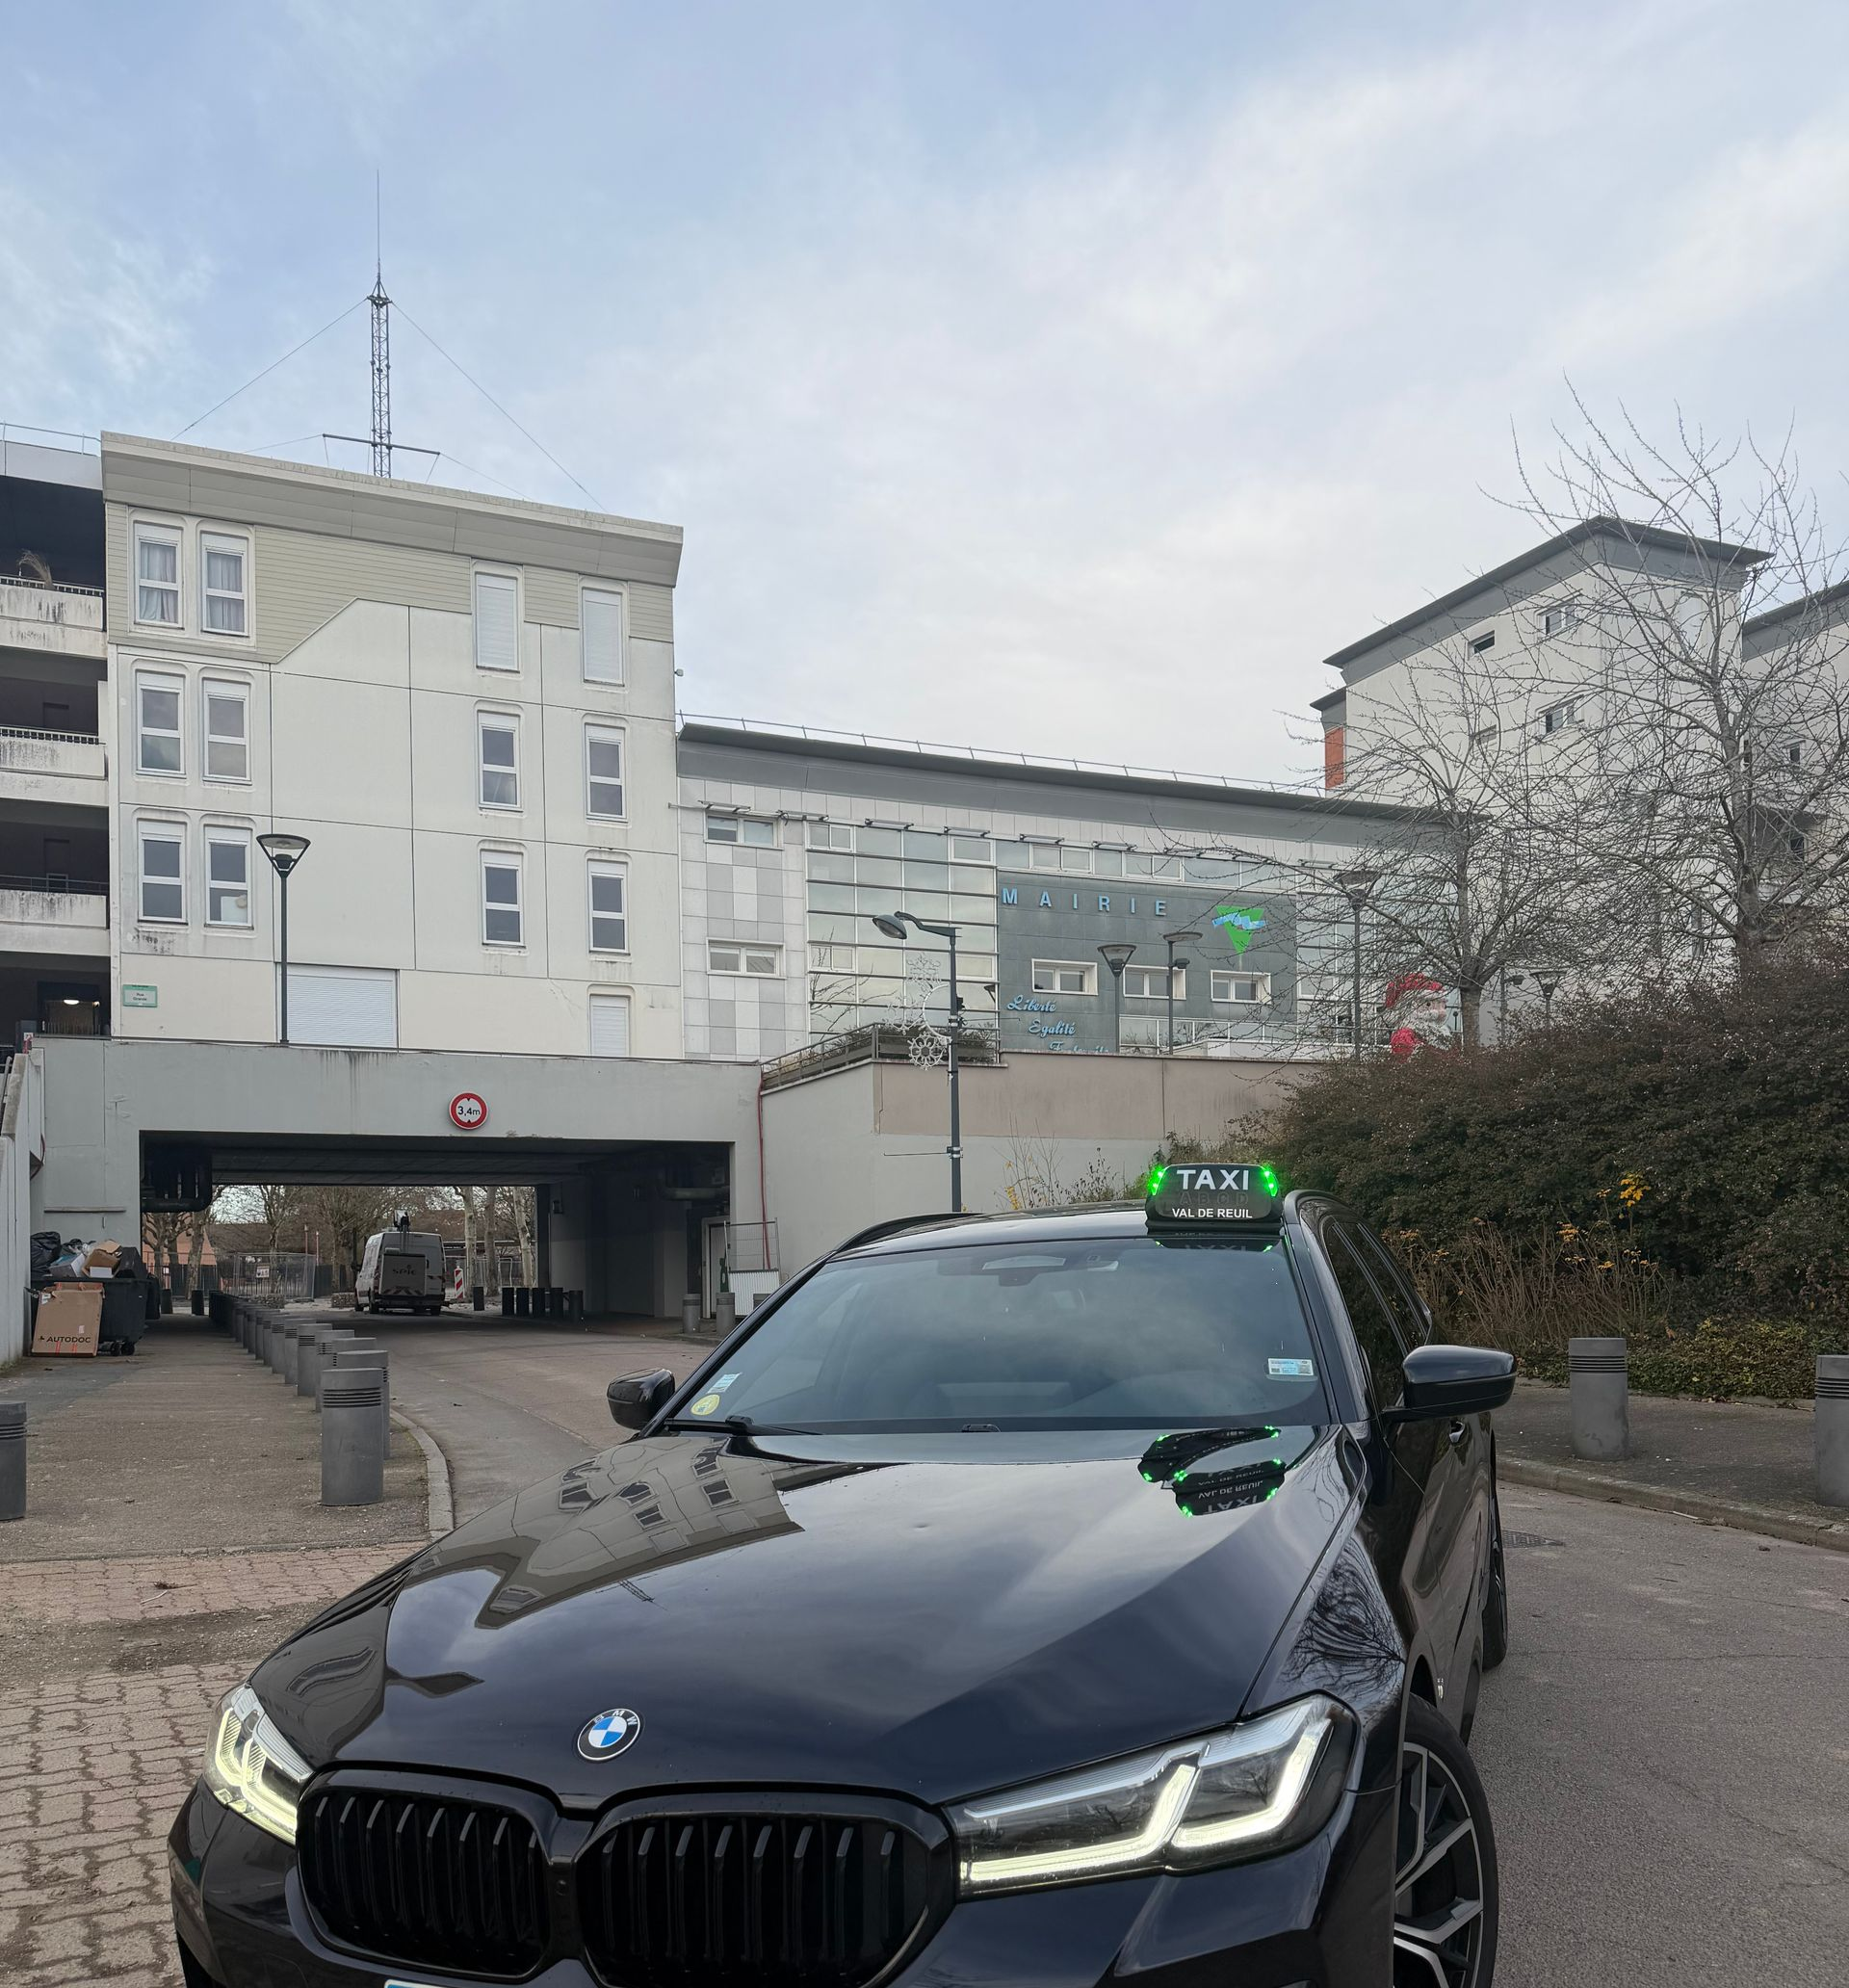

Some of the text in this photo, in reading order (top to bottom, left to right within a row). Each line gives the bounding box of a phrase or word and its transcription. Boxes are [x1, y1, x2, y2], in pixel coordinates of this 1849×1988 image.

[1002, 887, 1167, 917] MAIRIE
[1006, 994, 1057, 1013] Liberté
[1176, 1169, 1249, 1190] TAXI
[1172, 1208, 1253, 1218] VAL DE REUIL
[593, 1710, 638, 1726] BMW
